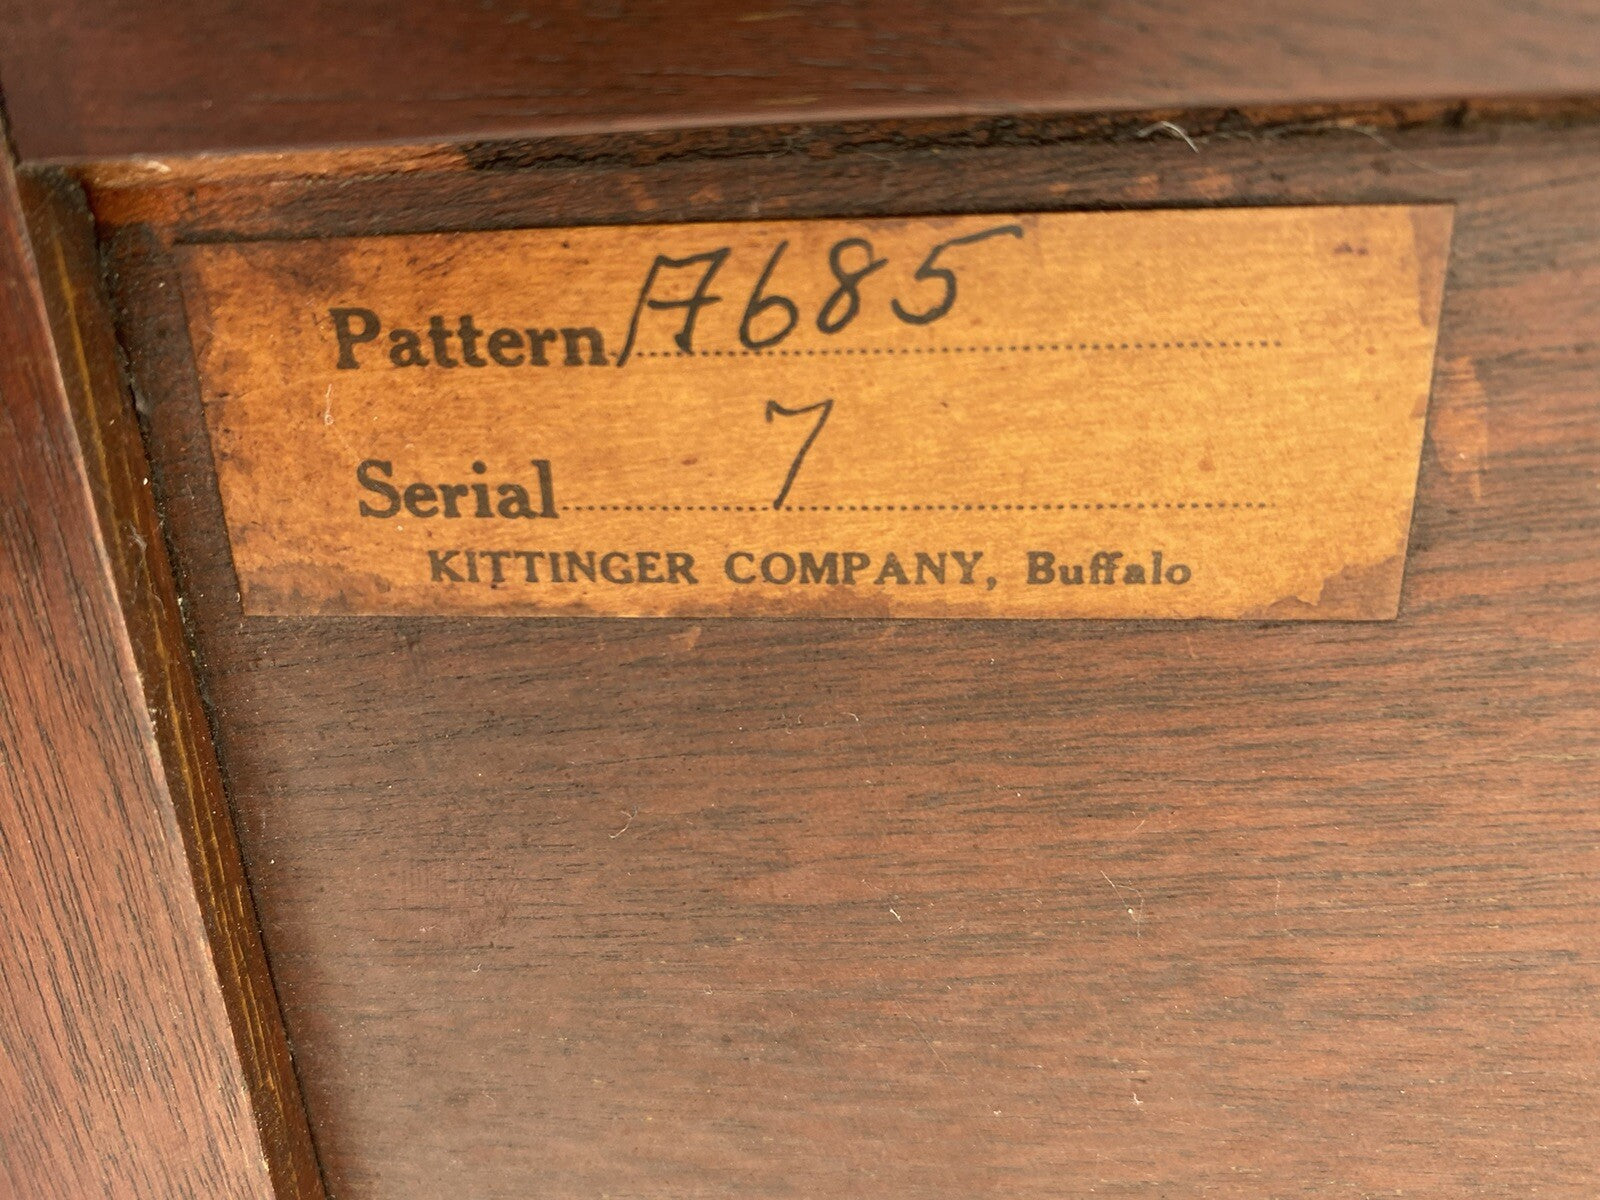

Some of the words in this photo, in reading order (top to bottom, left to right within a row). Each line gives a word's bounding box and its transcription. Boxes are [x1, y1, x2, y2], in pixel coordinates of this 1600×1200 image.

[328, 306, 610, 370] Pattern
[356, 459, 560, 519] Serial
[765, 398, 835, 511] 7
[427, 549, 700, 586] KITTINGER
[723, 550, 998, 591] COMPANY,
[1026, 550, 1194, 587] Buffalo
